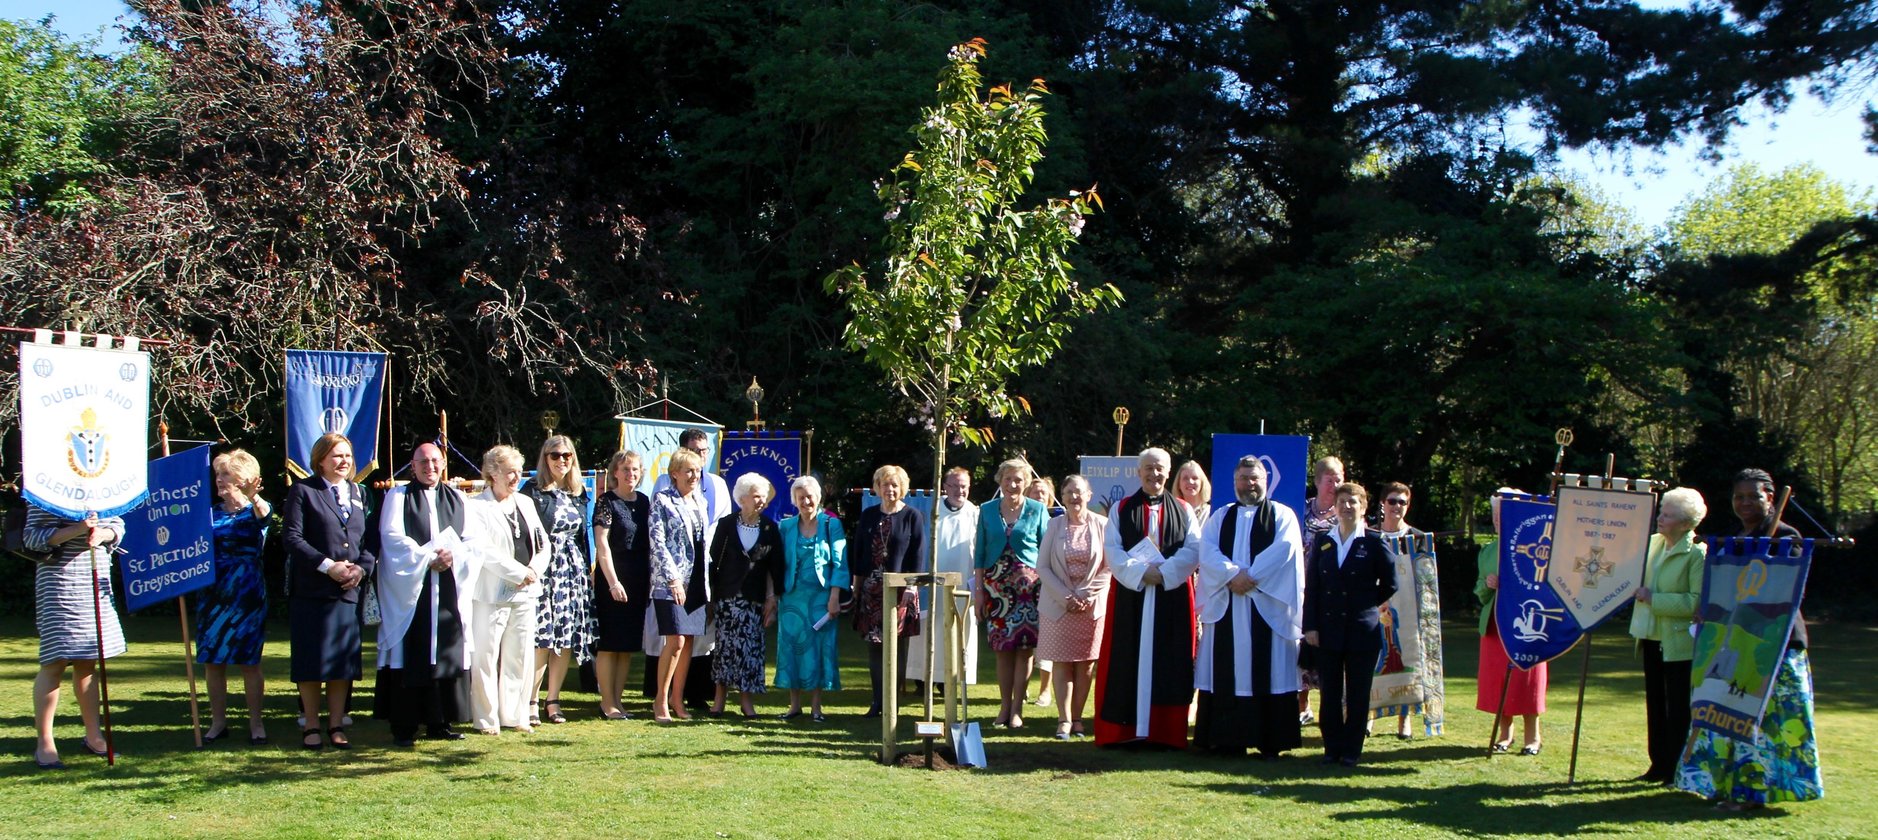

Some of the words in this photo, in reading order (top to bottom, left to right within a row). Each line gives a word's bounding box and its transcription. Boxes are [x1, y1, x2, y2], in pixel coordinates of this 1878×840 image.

[41, 384, 99, 408] DUBLIN
[105, 389, 133, 410] AND
[637, 431, 679, 453] TAN
[719, 445, 796, 484] ASTLEKNOCK
[1081, 466, 1120, 478] LEIXLIP
[35, 472, 138, 501] GLENDALOUGH
[129, 480, 202, 513] others'
[1586, 500, 1608, 509] SAINTS
[1611, 502, 1637, 511] RAHENY
[1576, 517, 1605, 526] MOTHERS
[1607, 520, 1627, 528] UNION
[128, 558, 147, 573] St
[150, 536, 209, 570] Patrick's
[129, 560, 211, 596] Greystones
[1556, 576, 1572, 596] DUBLIN
[1572, 597, 1583, 610] AND
[1592, 580, 1631, 612] GLENDALOUGH
